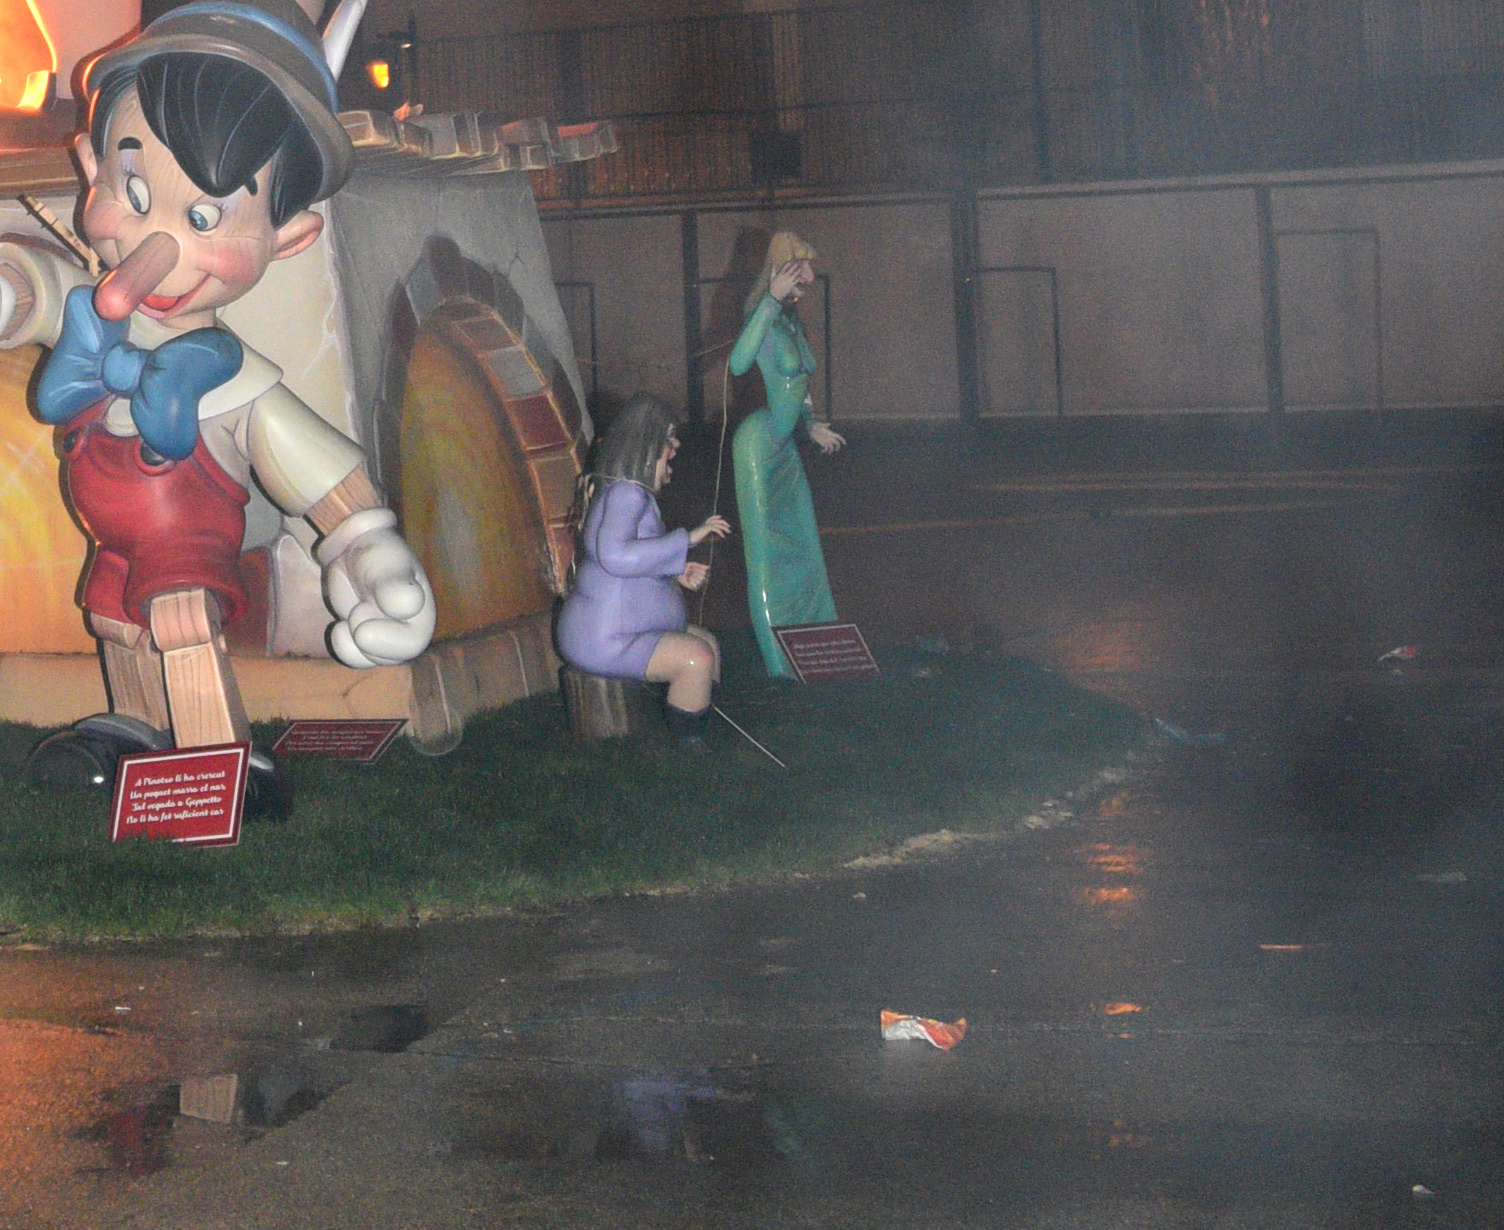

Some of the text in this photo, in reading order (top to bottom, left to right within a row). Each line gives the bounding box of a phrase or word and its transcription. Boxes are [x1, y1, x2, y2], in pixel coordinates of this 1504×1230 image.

[135, 778, 142, 787] A
[143, 777, 174, 786] Pinotxo
[175, 774, 182, 782] li
[183, 773, 195, 782] ha
[130, 783, 226, 800] Un poquet massa el nas
[132, 802, 145, 811] Tal
[147, 800, 176, 811] vegada
[185, 796, 222, 807] Geppetto
[126, 808, 224, 824] No li ha fet suficient cas
